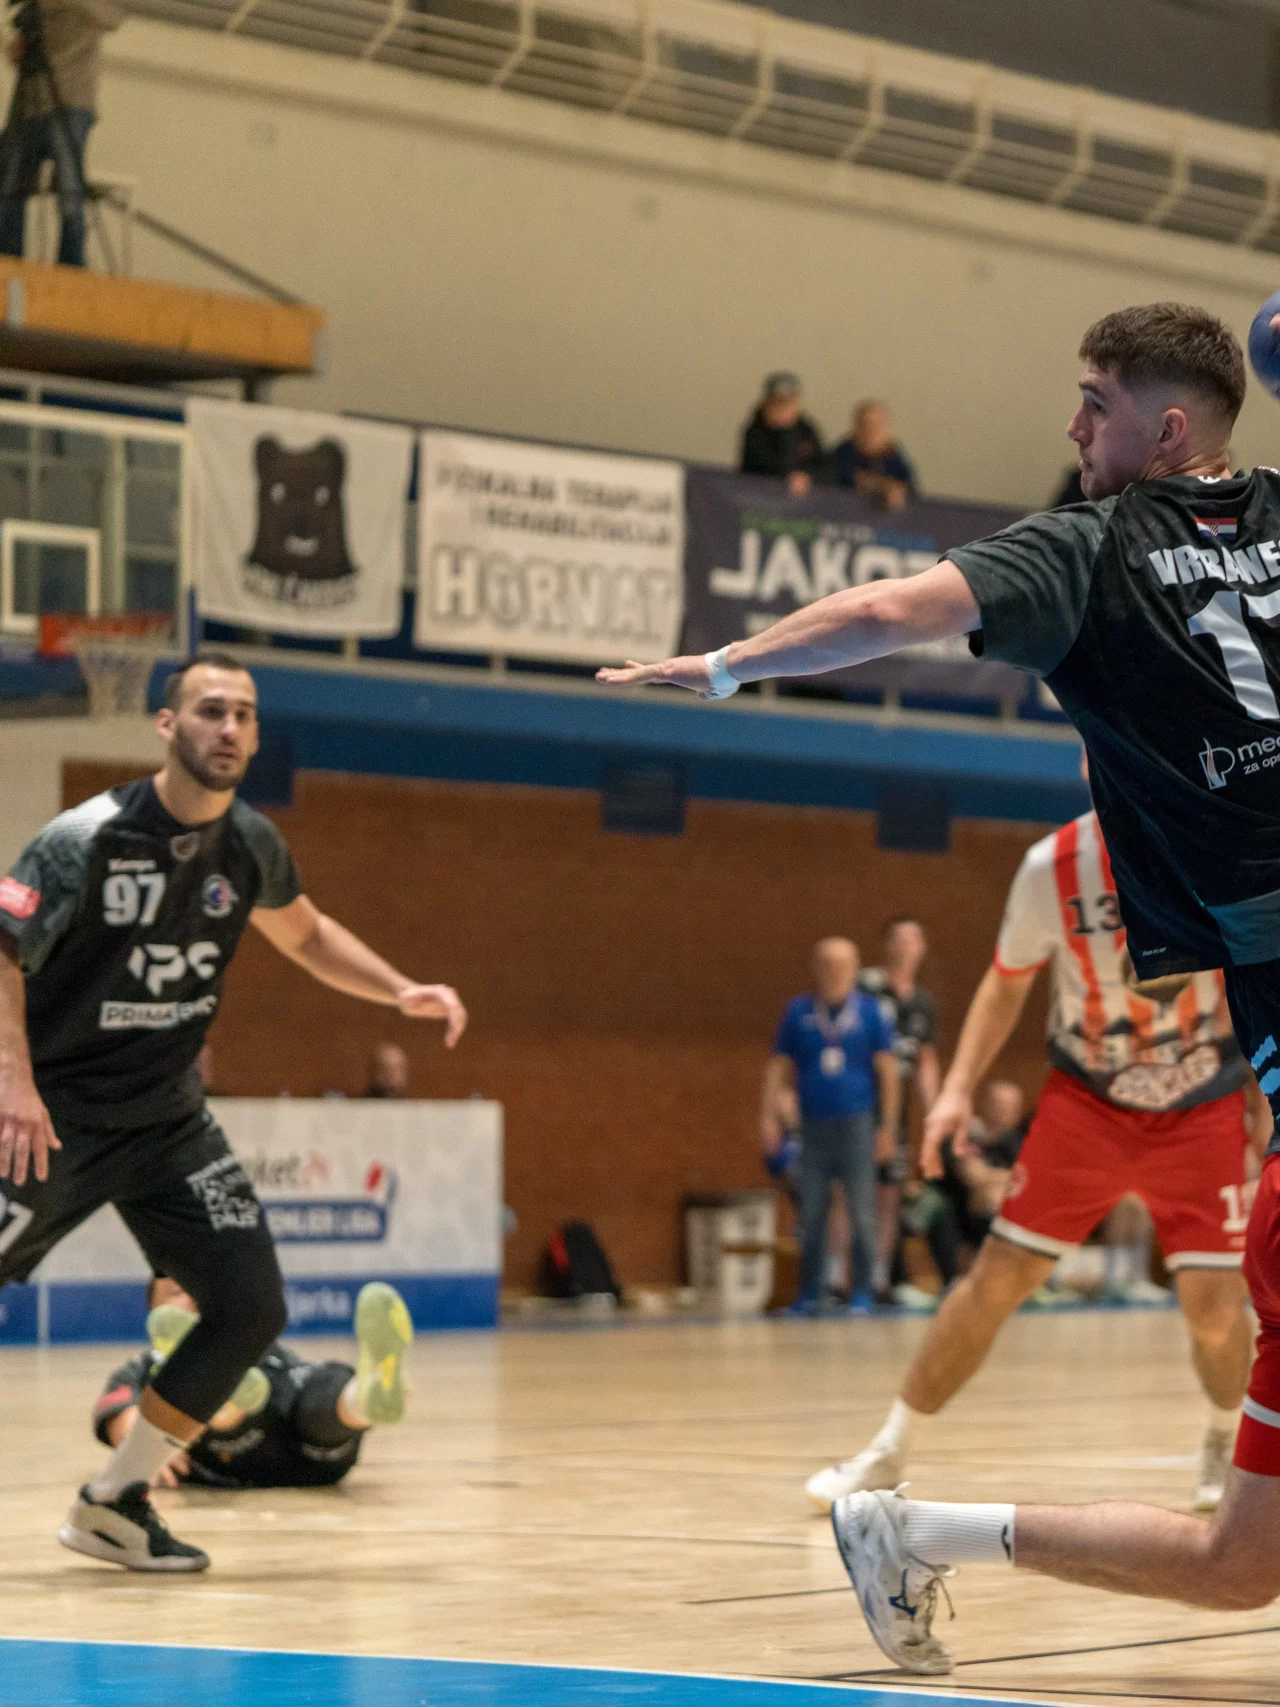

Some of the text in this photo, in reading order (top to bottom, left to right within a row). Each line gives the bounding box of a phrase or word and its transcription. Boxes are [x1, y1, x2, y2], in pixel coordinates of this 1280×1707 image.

[430, 545, 676, 645] HORVAT
[1243, 762, 1261, 775] za
[102, 873, 166, 926] 97
[1069, 894, 1123, 934] 13
